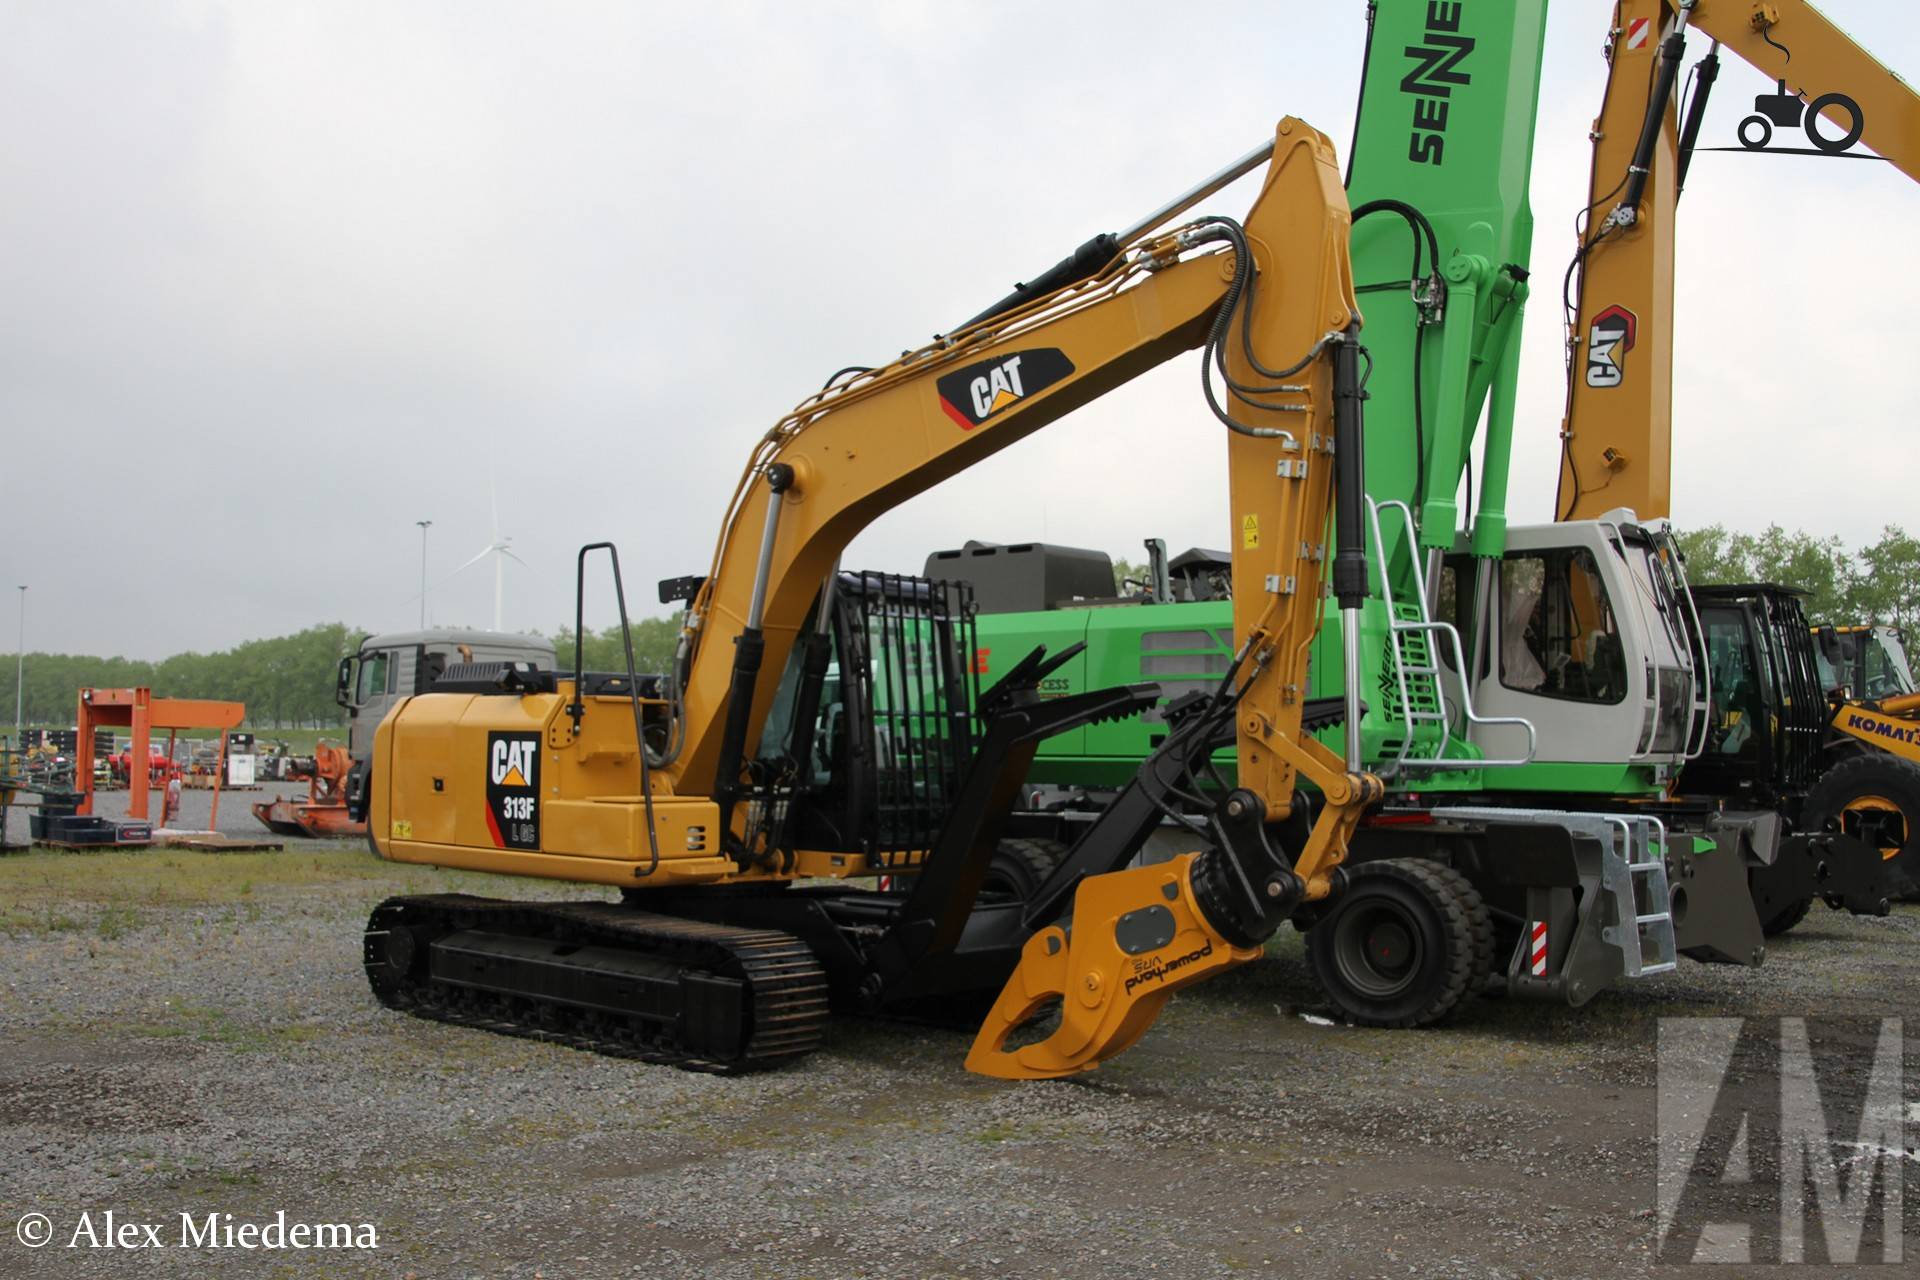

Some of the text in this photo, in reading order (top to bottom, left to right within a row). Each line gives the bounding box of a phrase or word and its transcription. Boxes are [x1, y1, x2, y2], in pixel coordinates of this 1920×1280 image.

[1400, 0, 1476, 166] SENNE
[1587, 325, 1625, 387] CAT
[970, 355, 1025, 419] CAT
[1040, 679, 1070, 690] CESS
[1378, 607, 1401, 722] SENNEBO
[491, 739, 537, 787] CAT
[503, 796, 535, 820] 313F
[1125, 938, 1213, 996] powerhand
